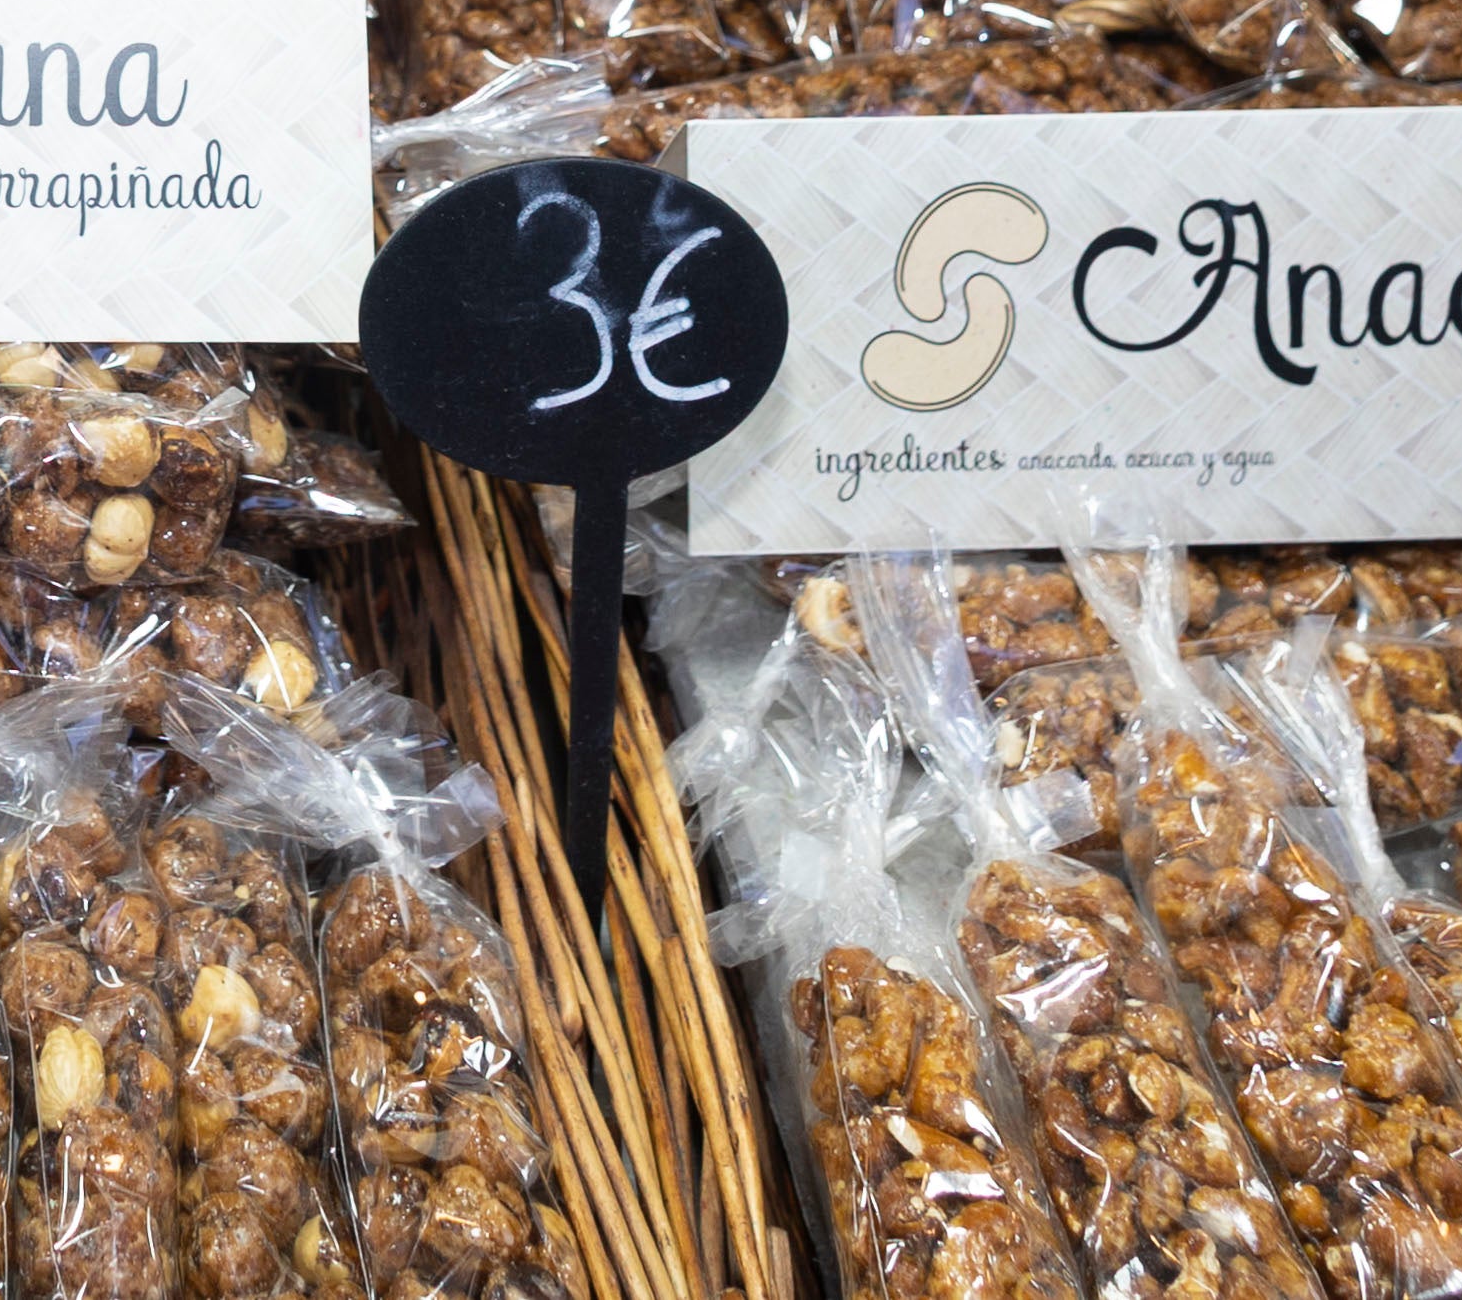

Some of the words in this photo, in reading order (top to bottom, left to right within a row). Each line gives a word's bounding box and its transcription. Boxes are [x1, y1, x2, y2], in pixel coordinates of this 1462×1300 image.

[516, 191, 731, 410] 3€
[1194, 453, 1217, 488] y
[1221, 450, 1276, 487] agua
